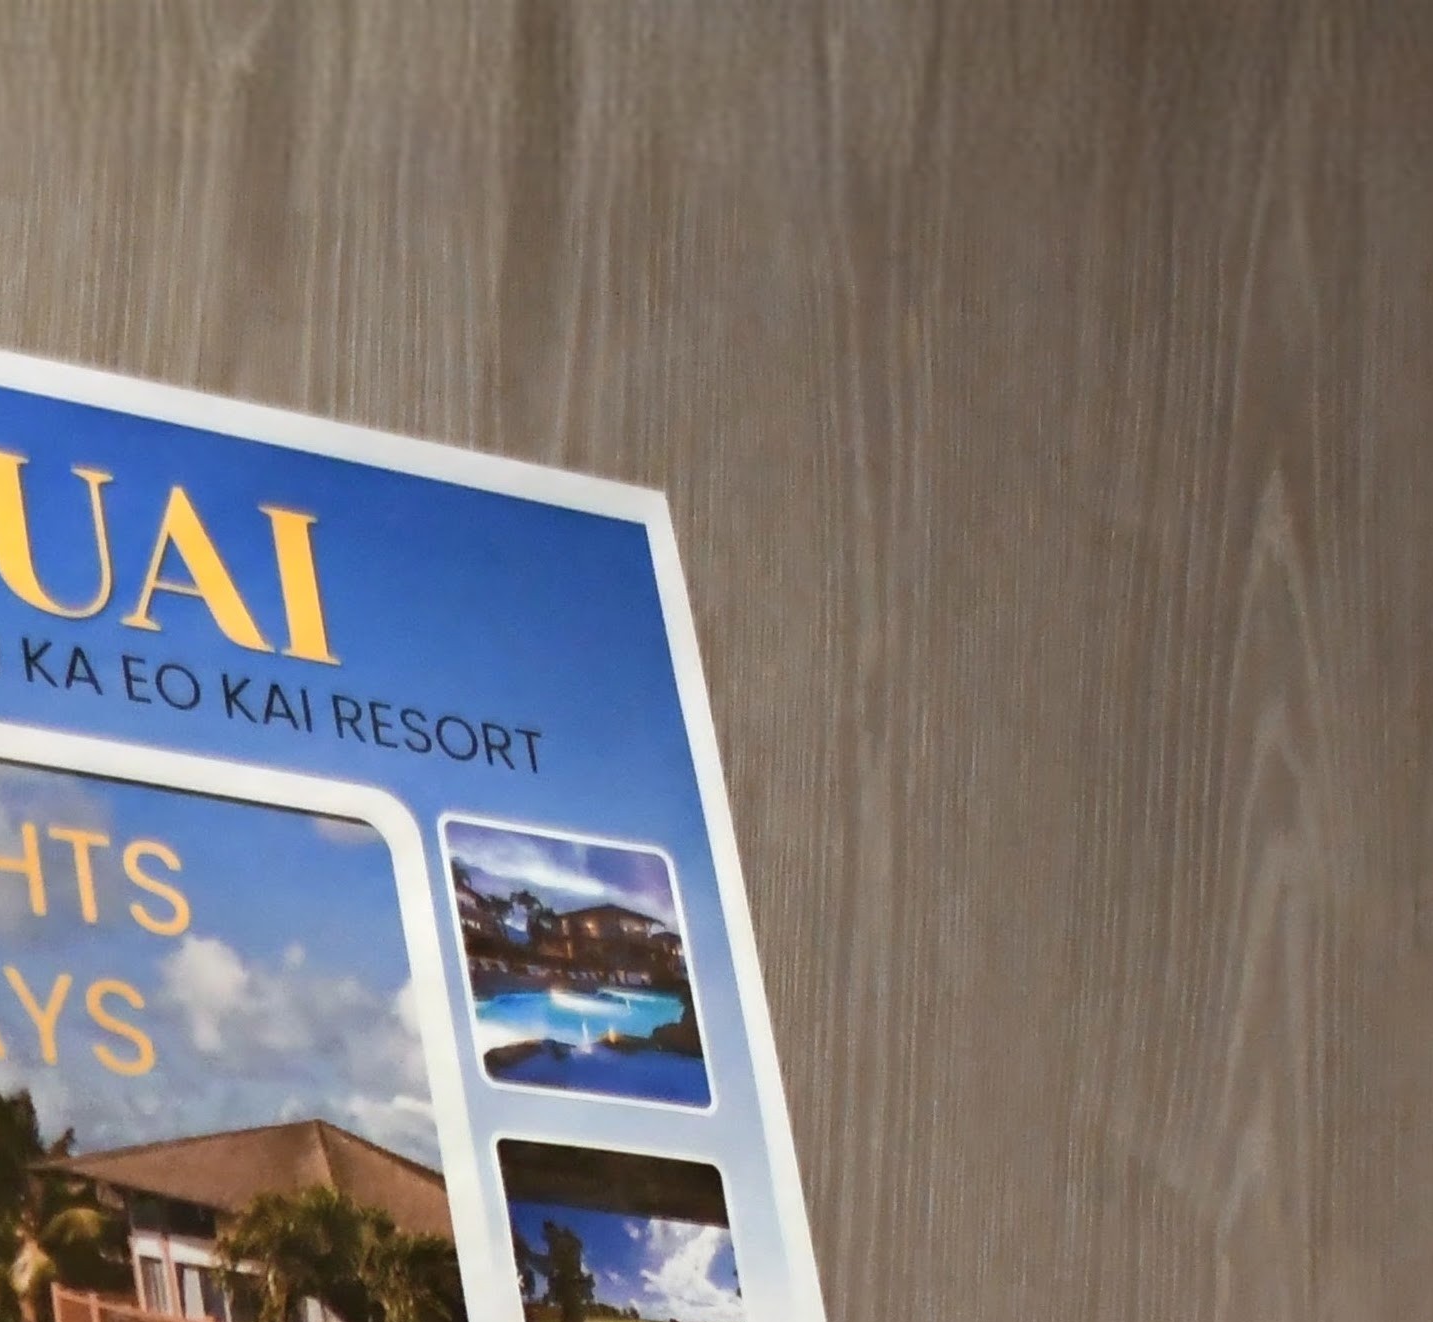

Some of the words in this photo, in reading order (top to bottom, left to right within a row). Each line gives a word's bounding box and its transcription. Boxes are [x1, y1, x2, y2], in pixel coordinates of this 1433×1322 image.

[21, 637, 103, 696] KA
[121, 653, 201, 710] EO
[222, 672, 313, 733] KAI
[332, 692, 543, 773] RESORT
